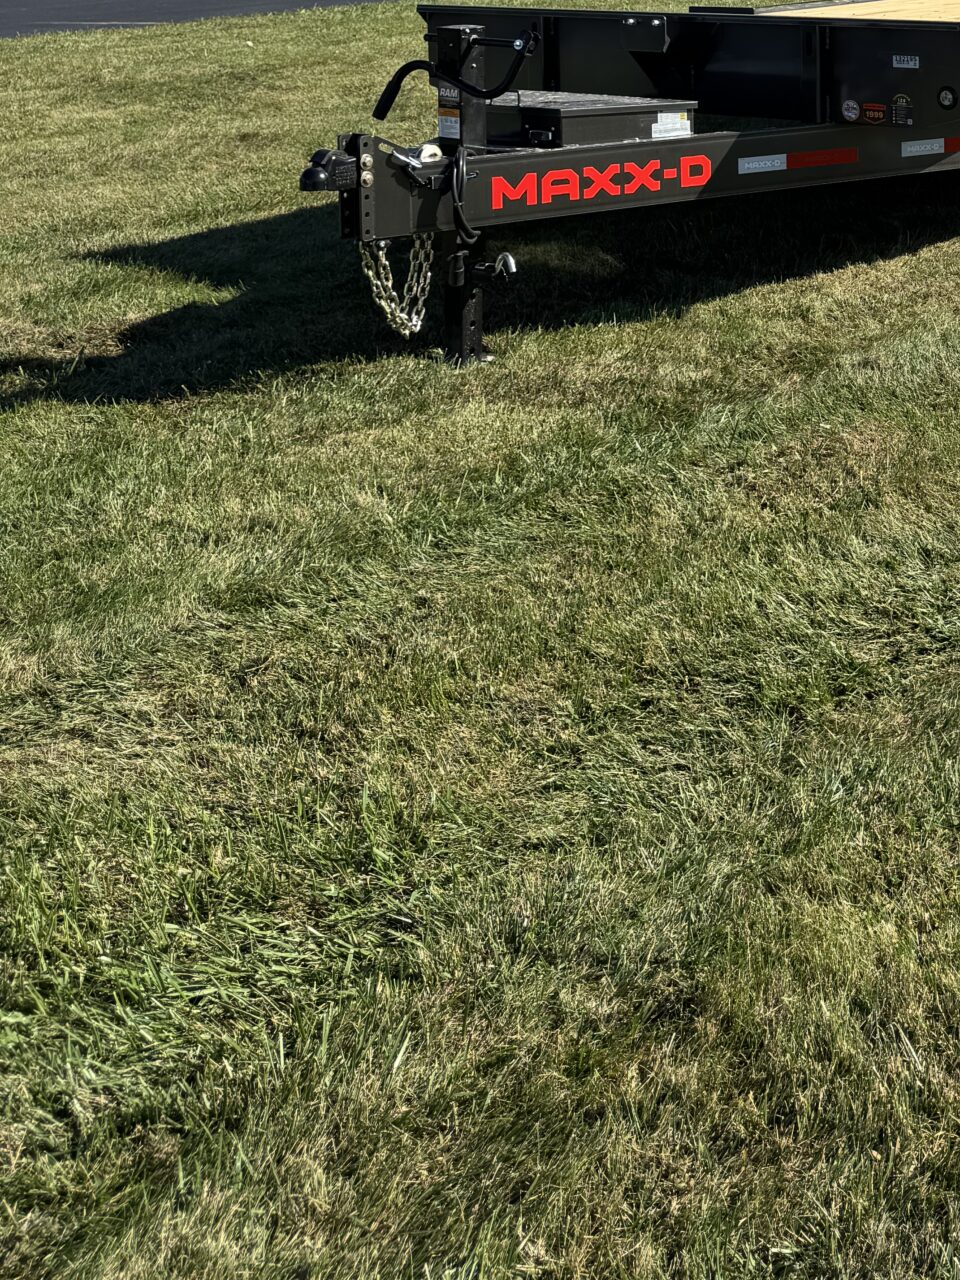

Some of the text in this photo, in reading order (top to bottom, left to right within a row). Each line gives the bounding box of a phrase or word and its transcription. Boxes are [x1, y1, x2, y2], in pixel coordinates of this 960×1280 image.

[440, 87, 458, 98] RAM
[744, 159, 781, 170] MAXX-D
[491, 154, 712, 210] MAXX-D
